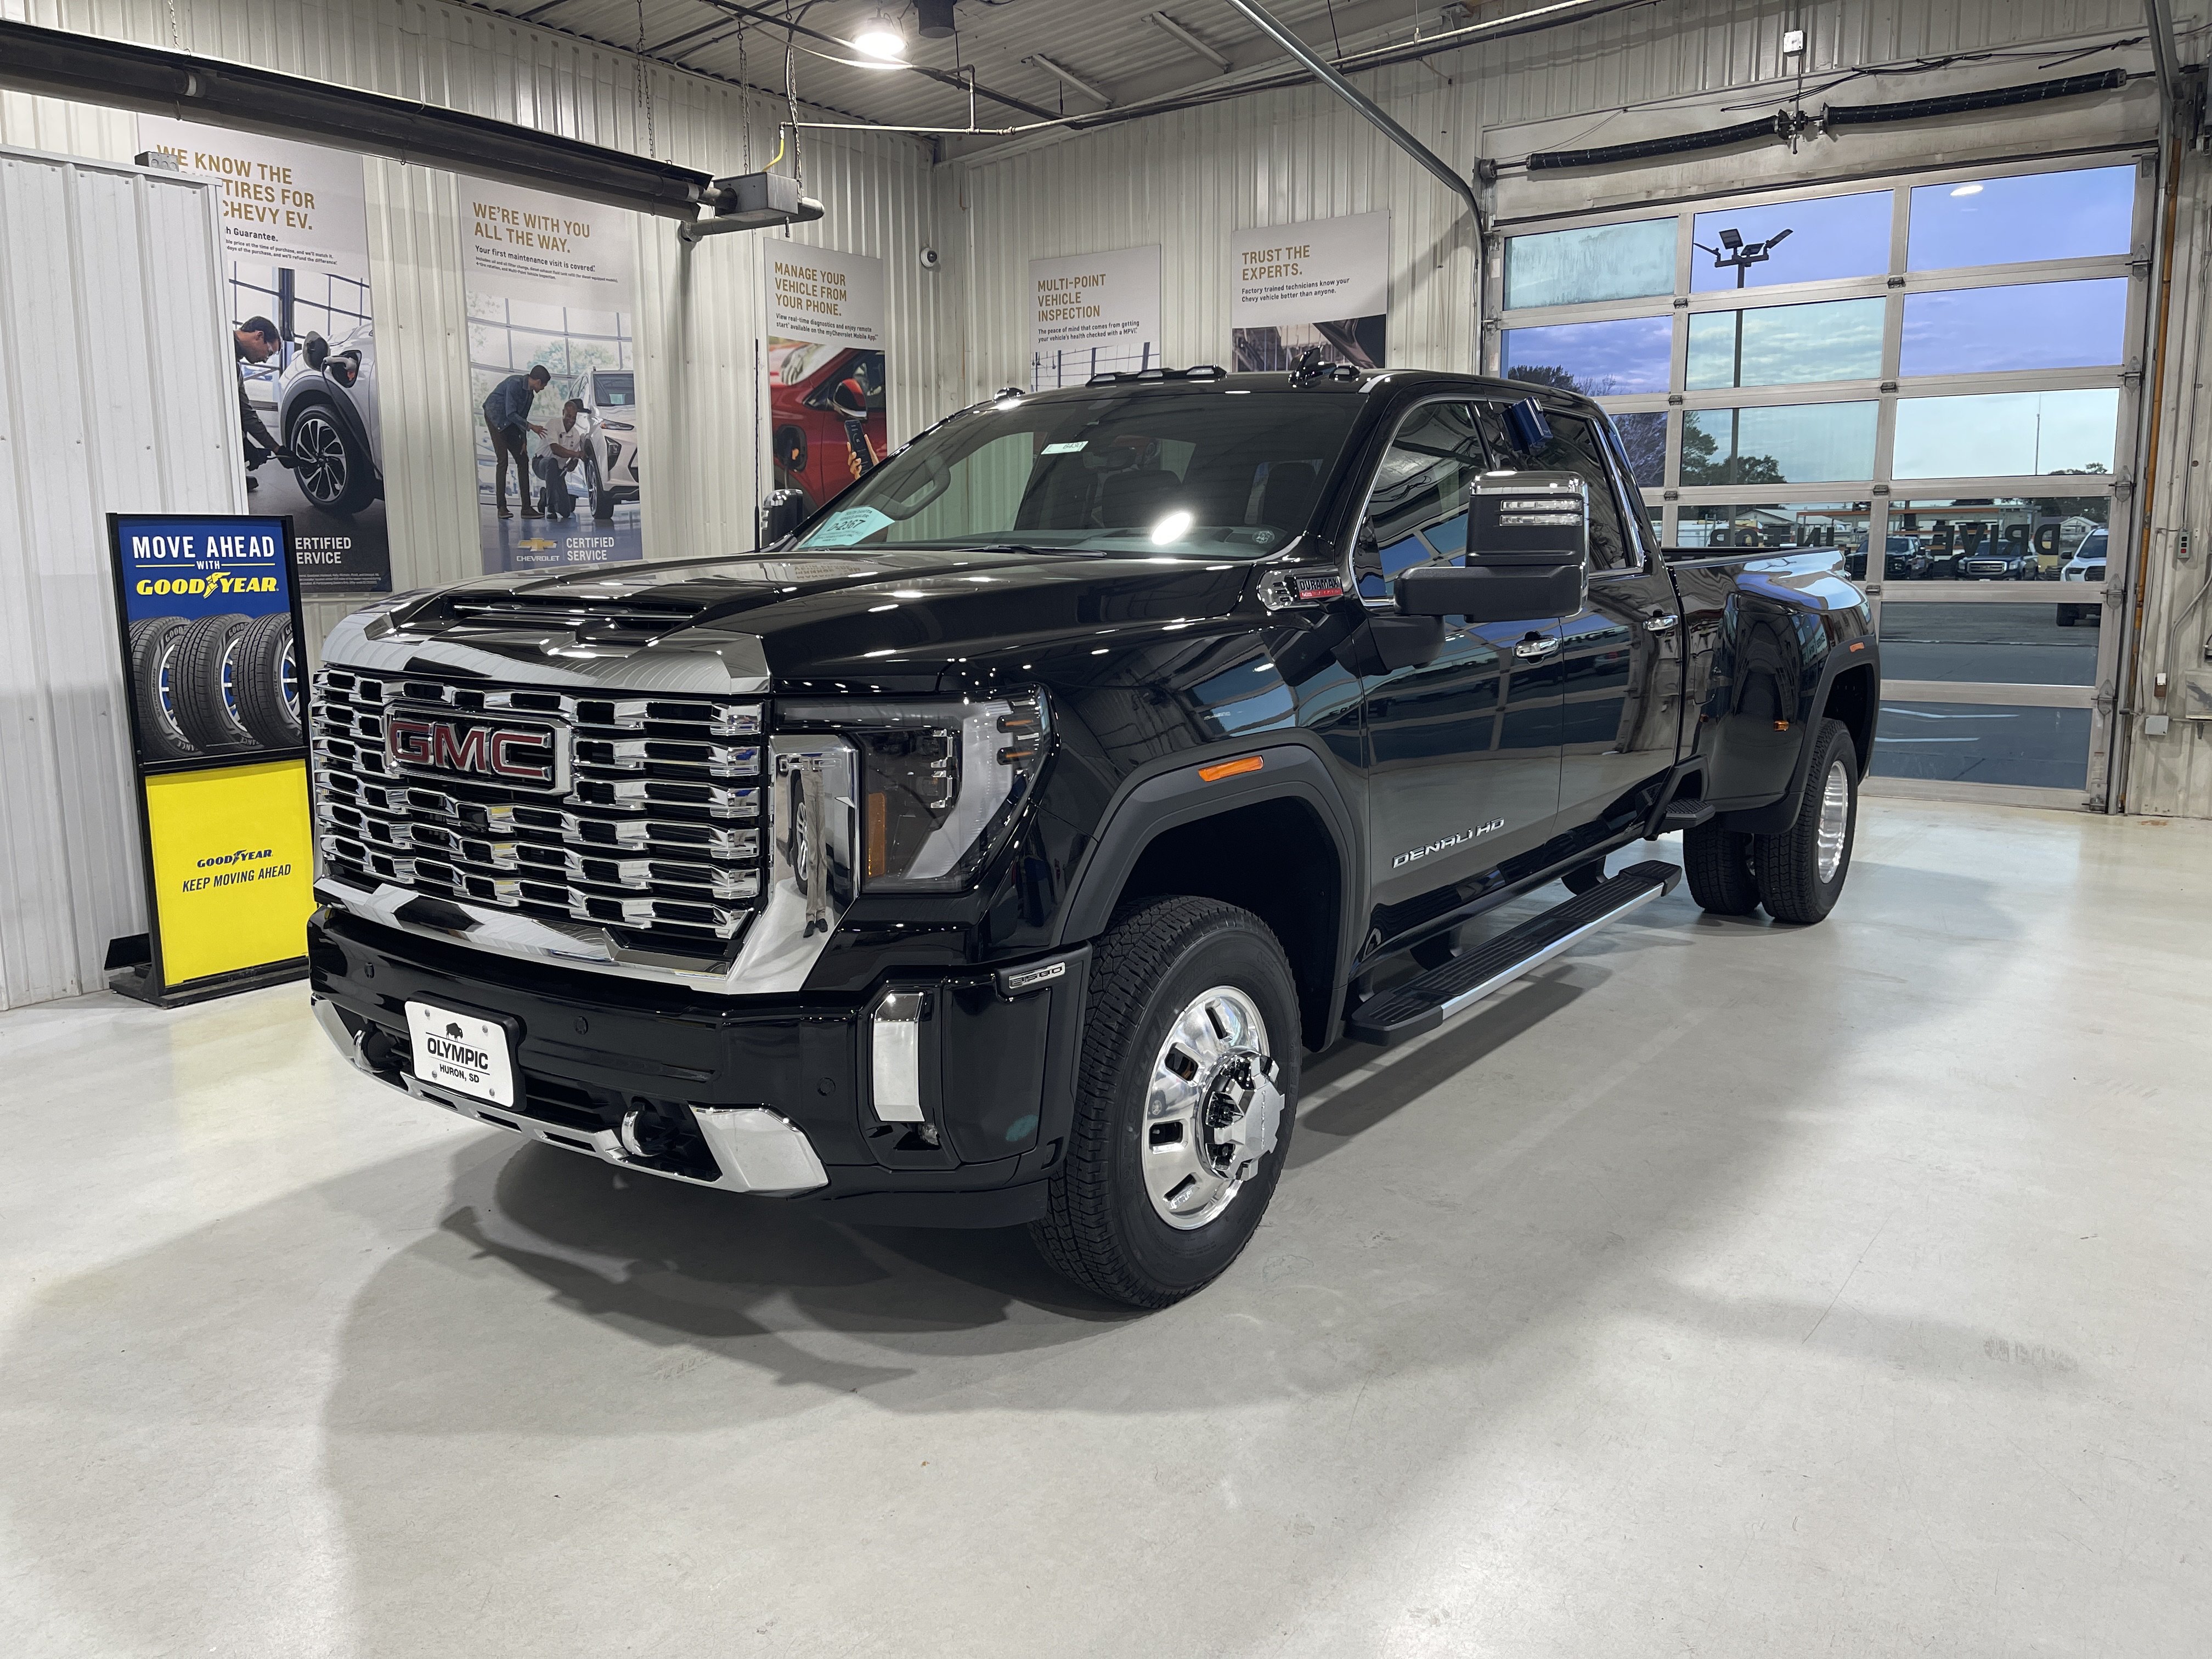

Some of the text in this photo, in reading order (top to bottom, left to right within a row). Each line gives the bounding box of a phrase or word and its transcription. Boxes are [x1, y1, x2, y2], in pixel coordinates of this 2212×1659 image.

[195, 152, 251, 177] KNOW
[257, 163, 292, 185] THE
[222, 178, 315, 210] TIRES FOR
[286, 210, 313, 230] EV.
[472, 201, 590, 238] WE'RE WITH YOU
[234, 228, 278, 241] Guarantee.
[474, 222, 571, 253] ALL THE WAY.
[475, 245, 490, 254] Your
[492, 249, 506, 258] first
[508, 253, 548, 265] maintenance
[1242, 245, 1310, 264] TRUST THE
[775, 262, 846, 286] MANAGE YOUR
[1243, 263, 1302, 281] EXPERTS.
[775, 277, 847, 302] VEHICLE FROM
[1037, 274, 1106, 292] MULTI-POINT
[1265, 284, 1284, 292] trained
[1286, 282, 1318, 290] technicians
[775, 293, 842, 316] YOUR PHONE.
[1037, 292, 1081, 307] VEHICLE
[1039, 305, 1101, 322] INSPECTION
[810, 319, 835, 328] diagnostics
[132, 536, 274, 558] MOVE AHEAD
[295, 537, 351, 550] ERTIFIED
[566, 537, 614, 549] CERTIFIED
[196, 560, 220, 570] WITH
[296, 551, 342, 565] ERVICE
[567, 550, 607, 561] SERVICE
[136, 575, 278, 596] GOODYEAR
[1300, 579, 1338, 590] DURAMAX
[389, 719, 552, 781] GMC
[1392, 817, 1504, 868] DENALI HD
[197, 849, 272, 868] GOODYEAR
[182, 864, 291, 893] KEEP MOVING AHEAD
[427, 1037, 488, 1070] OLYMPIC
[439, 1064, 479, 1083] HURON, SD
